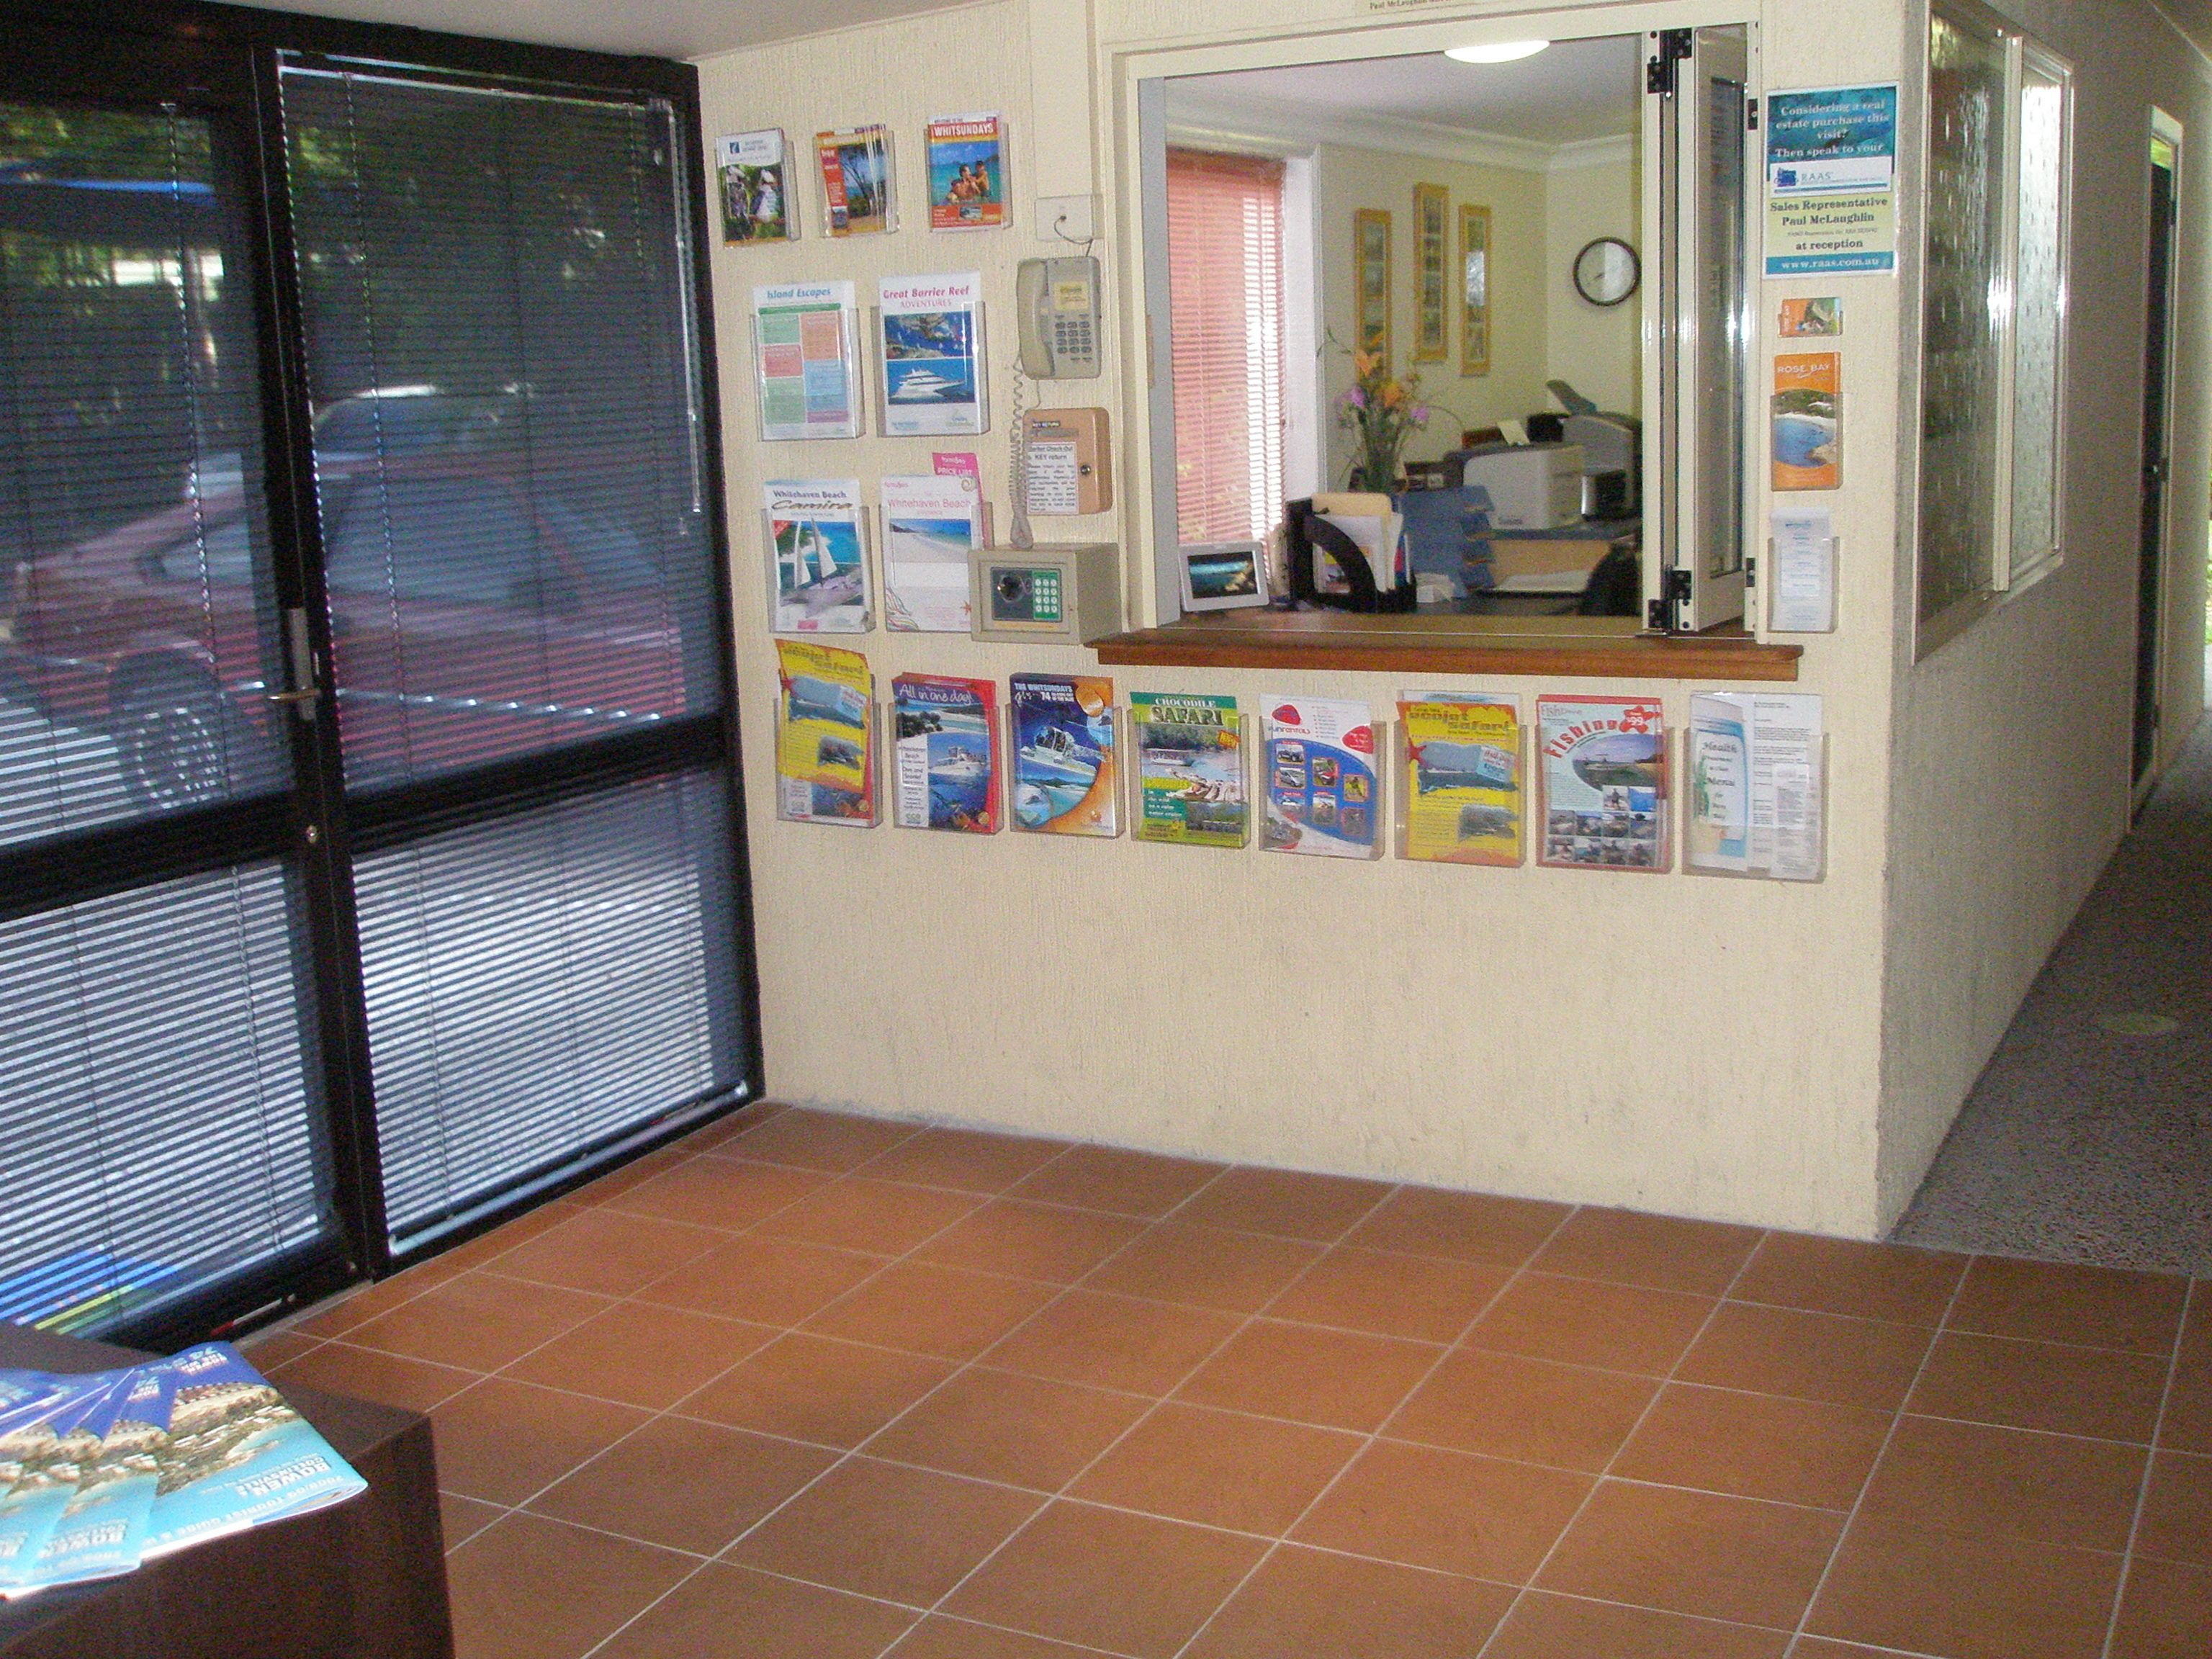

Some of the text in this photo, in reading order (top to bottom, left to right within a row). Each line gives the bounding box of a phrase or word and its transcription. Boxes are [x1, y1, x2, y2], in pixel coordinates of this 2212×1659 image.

[1781, 102, 1851, 117] Considering
[1862, 100, 1885, 110] real
[1776, 113, 1889, 130] estate purchase this
[934, 122, 994, 138] WHITSUNDAYS
[1817, 128, 1848, 140] visit?
[1775, 143, 1884, 158] Then speak to your
[1770, 197, 1887, 212] Sales Representative
[1782, 213, 1874, 226] Paul McLaughlin
[1796, 238, 1863, 250] at reception
[1781, 257, 1879, 269] www.raas.com.au
[768, 288, 831, 299] Island Escapes
[884, 285, 970, 299] Great Barrier Reef
[1811, 363, 1830, 372] BAY
[773, 490, 819, 499] Whitehaven
[899, 683, 917, 698] All
[930, 692, 948, 702] one
[1155, 698, 1216, 708] CROCODILE
[1151, 706, 1224, 726] SAFARI
[253, 1461, 331, 1496] BOWEN
